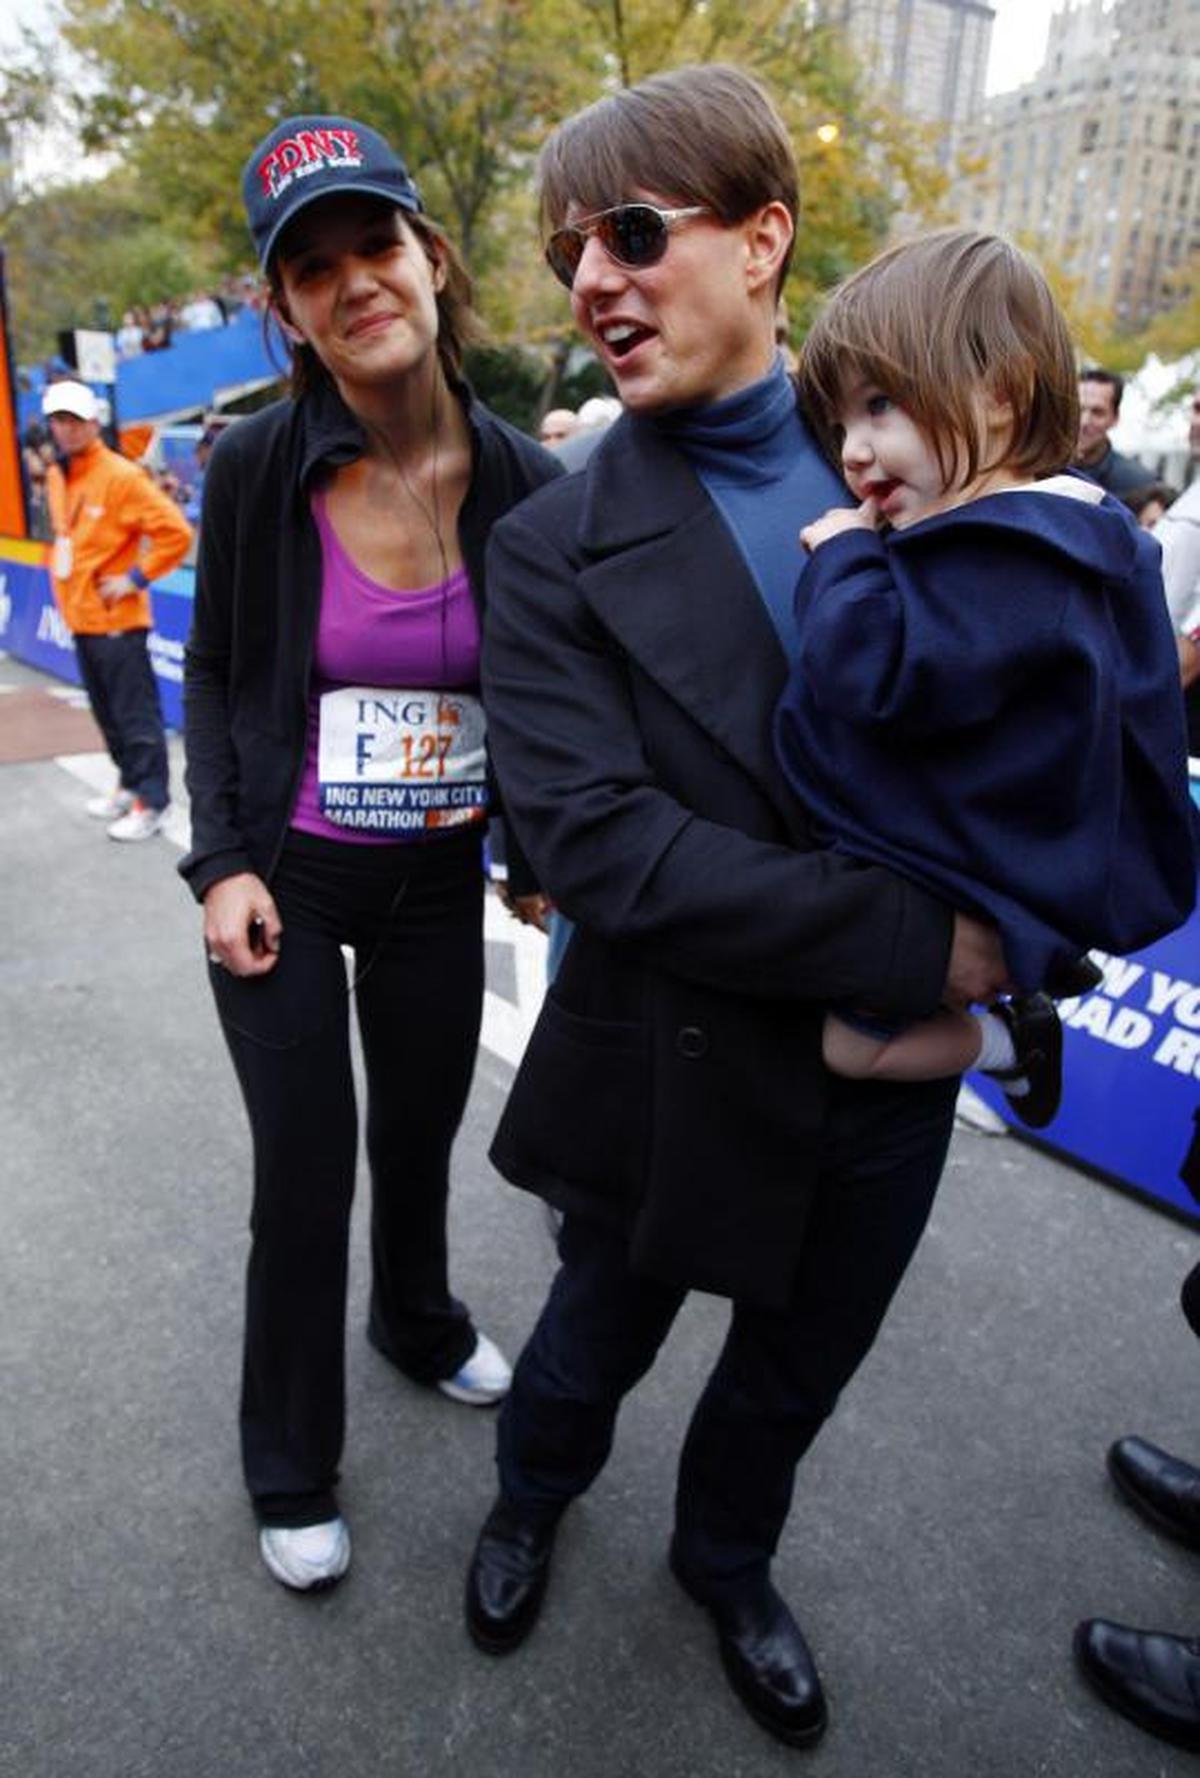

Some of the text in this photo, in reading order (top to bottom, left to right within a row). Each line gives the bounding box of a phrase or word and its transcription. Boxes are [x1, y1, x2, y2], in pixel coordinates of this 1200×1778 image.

[257, 128, 364, 199] FDNY
[357, 700, 427, 726] ING
[356, 733, 453, 778] F 127
[326, 786, 484, 807] ING NEW YORK CITY
[324, 808, 425, 830] MARATHON
